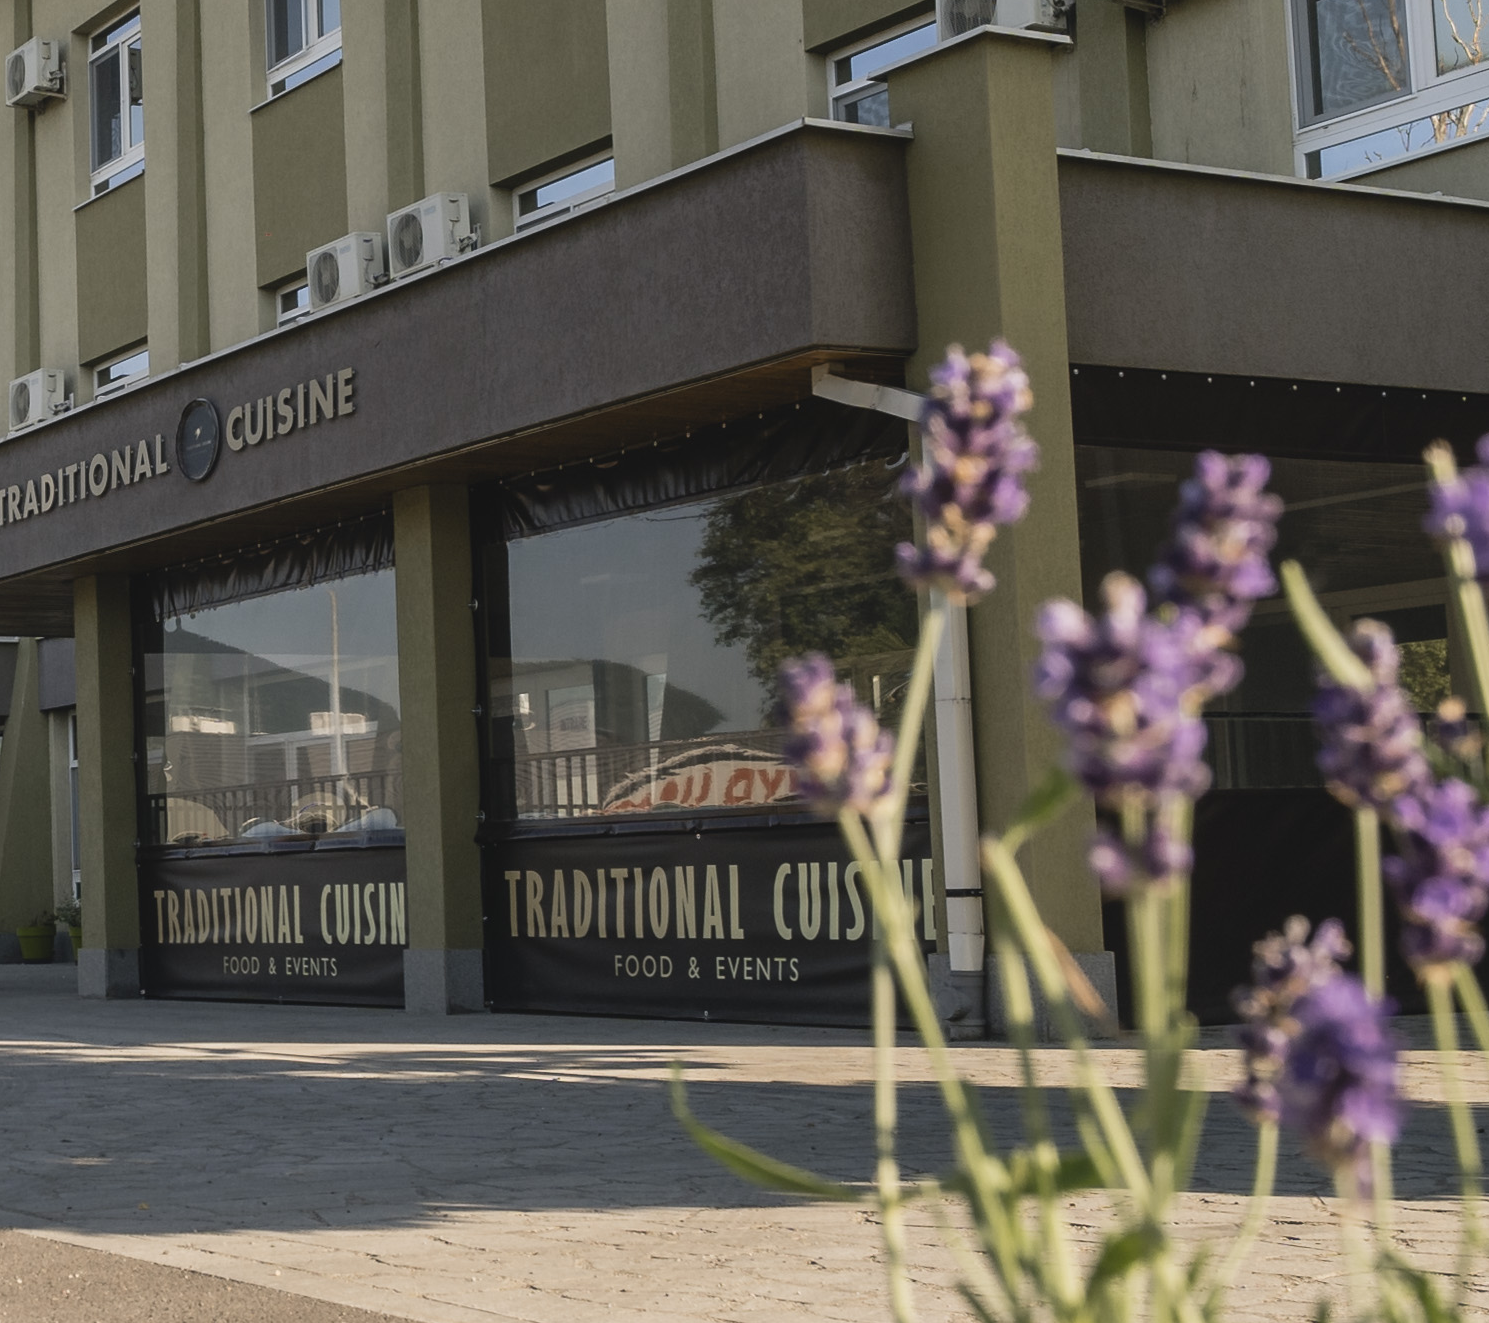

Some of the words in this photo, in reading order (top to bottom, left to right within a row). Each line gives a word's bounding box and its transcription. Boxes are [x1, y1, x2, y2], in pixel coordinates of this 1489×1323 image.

[225, 367, 354, 451] CUISINE
[153, 885, 304, 944] TRADITIONAL
[504, 864, 745, 940] TRADITIONAL
[223, 956, 260, 975] FOOD
[268, 958, 277, 975] &
[285, 957, 338, 977] EVENTS
[614, 955, 673, 978] FOOD
[688, 957, 700, 979] &
[716, 957, 799, 982] EVENTS
